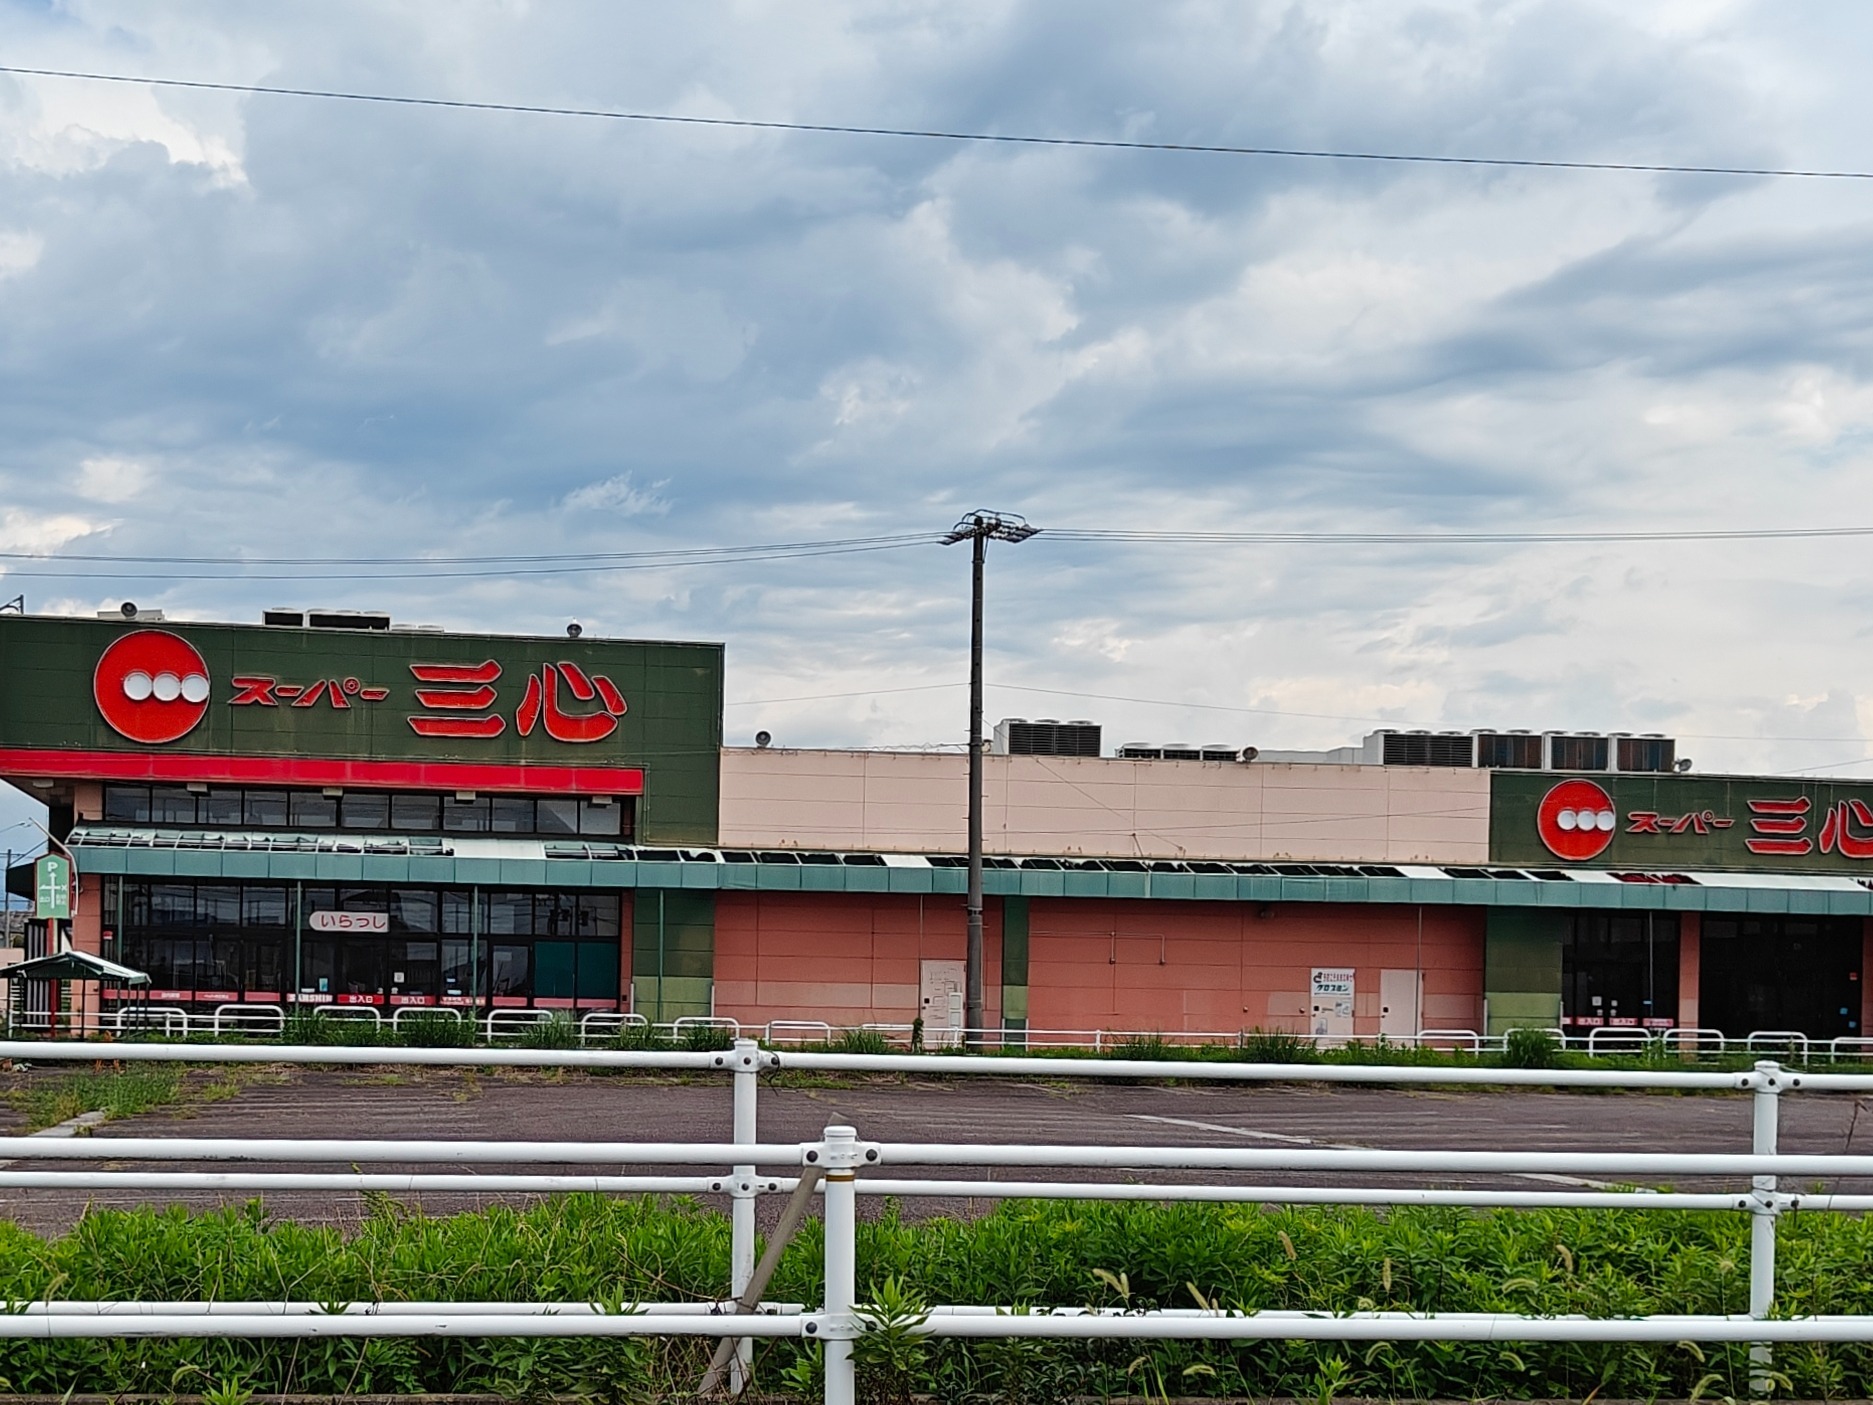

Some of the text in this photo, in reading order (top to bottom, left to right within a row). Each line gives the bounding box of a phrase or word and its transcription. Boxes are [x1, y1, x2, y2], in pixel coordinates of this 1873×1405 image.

[47, 861, 58, 872] P
[348, 995, 374, 1004] 出入口
